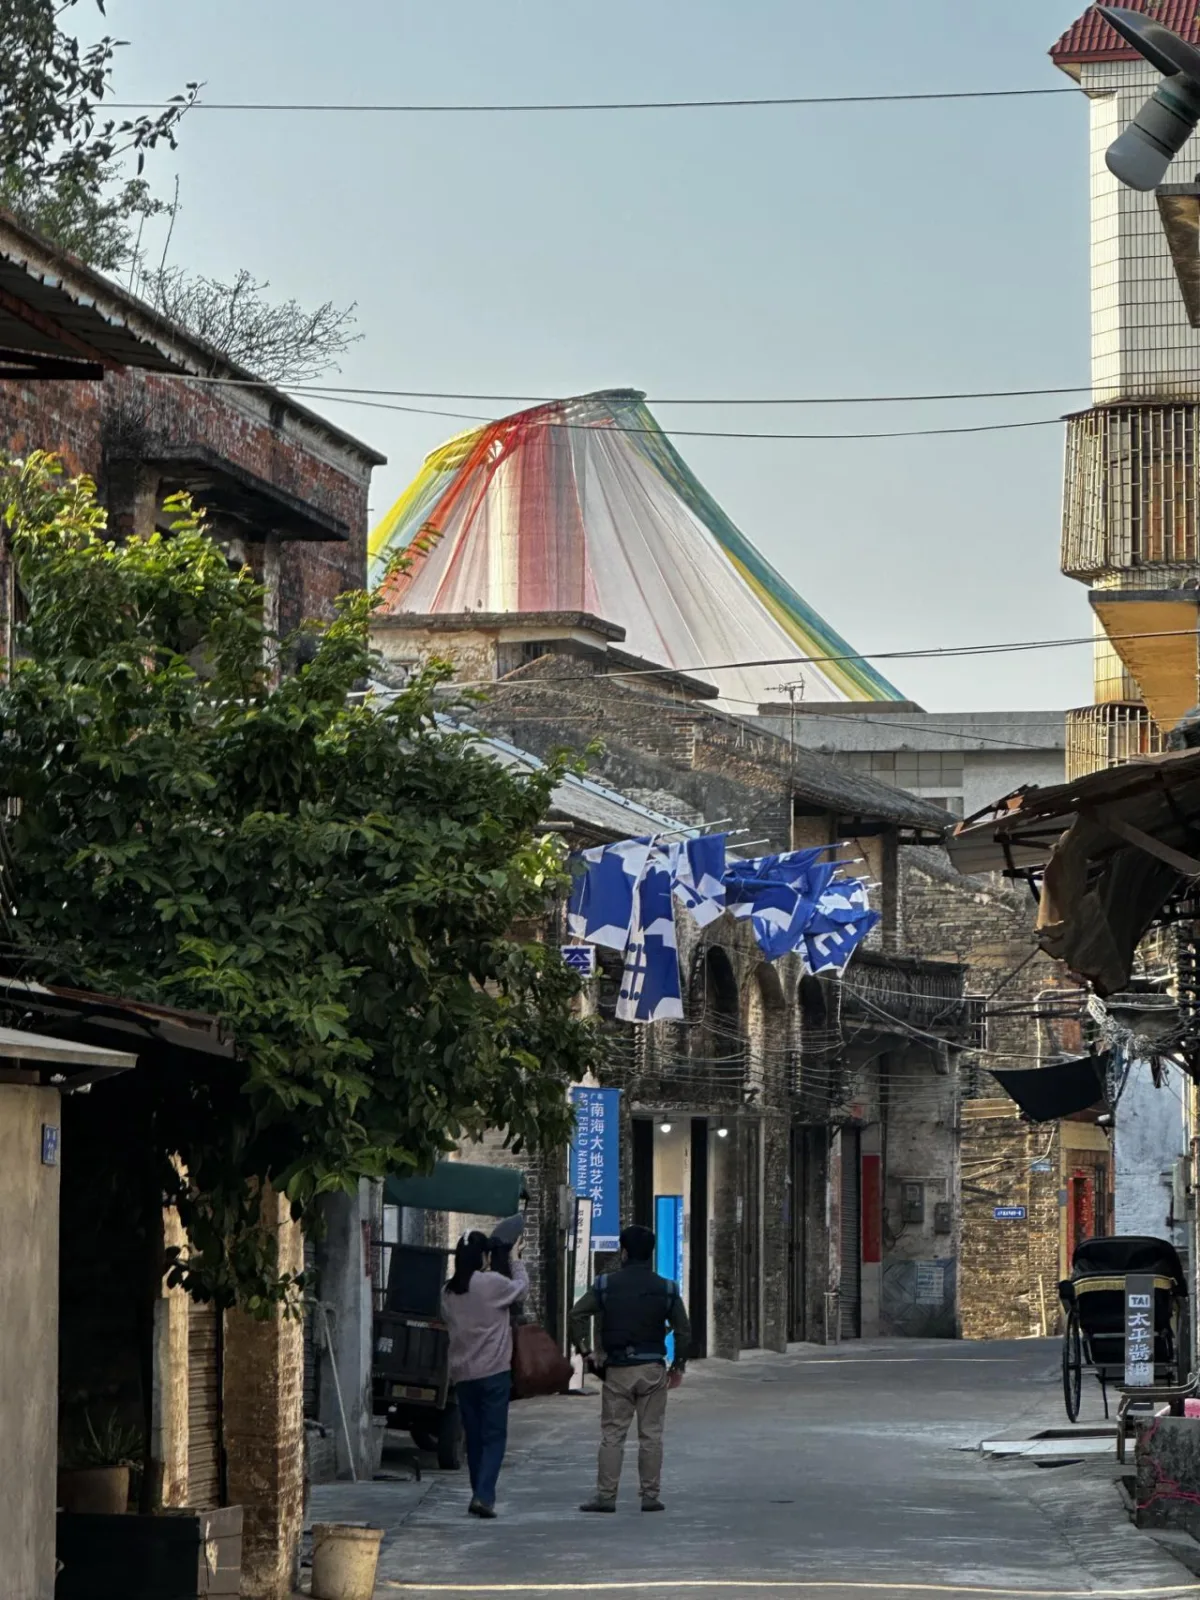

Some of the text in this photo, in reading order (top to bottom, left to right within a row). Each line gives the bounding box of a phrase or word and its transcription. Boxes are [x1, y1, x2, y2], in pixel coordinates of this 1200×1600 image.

[578, 1116, 588, 1146] FIELD
[577, 1150, 588, 1189] NANHAI
[589, 1102, 605, 1218] 南海大地艺术节
[1131, 1297, 1149, 1306] TAI
